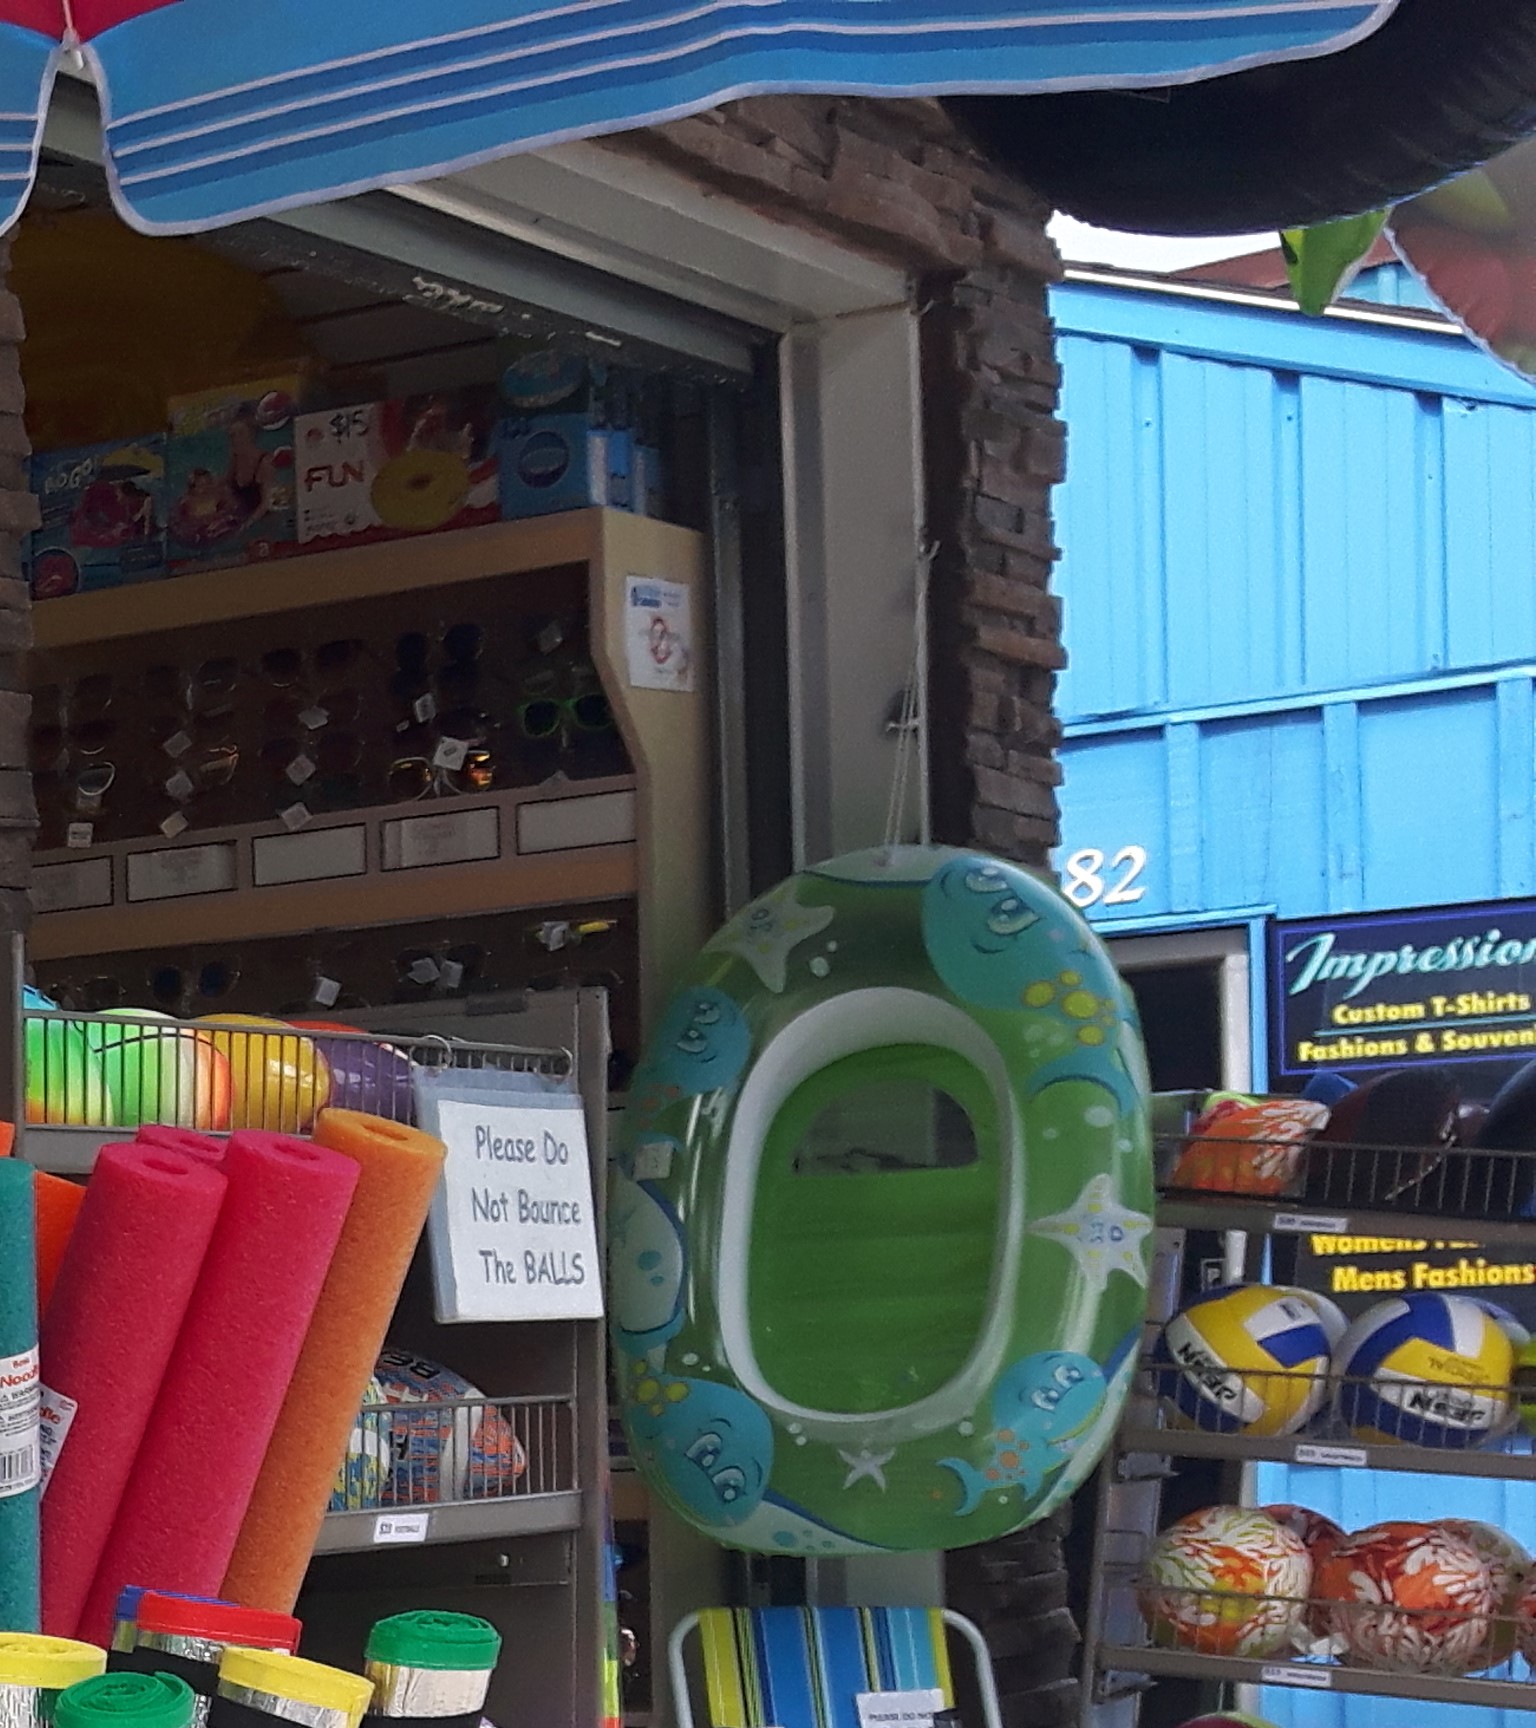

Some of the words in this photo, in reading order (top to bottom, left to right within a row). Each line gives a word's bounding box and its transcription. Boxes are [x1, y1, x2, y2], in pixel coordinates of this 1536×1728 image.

[1063, 845, 1147, 906] 82
[1332, 1002, 1426, 1025] Custom
[1432, 991, 1531, 1017] T-Shirts
[1299, 1036, 1408, 1061] Fashions
[1414, 1033, 1436, 1053] &
[475, 1124, 535, 1164] Please
[543, 1130, 569, 1164] Do
[473, 1188, 509, 1224] Not
[519, 1190, 581, 1224] Bounce
[479, 1249, 516, 1285] The
[524, 1251, 587, 1285] BALLS
[1333, 1266, 1406, 1293] Mens
[1413, 1258, 1536, 1289] Fashions
